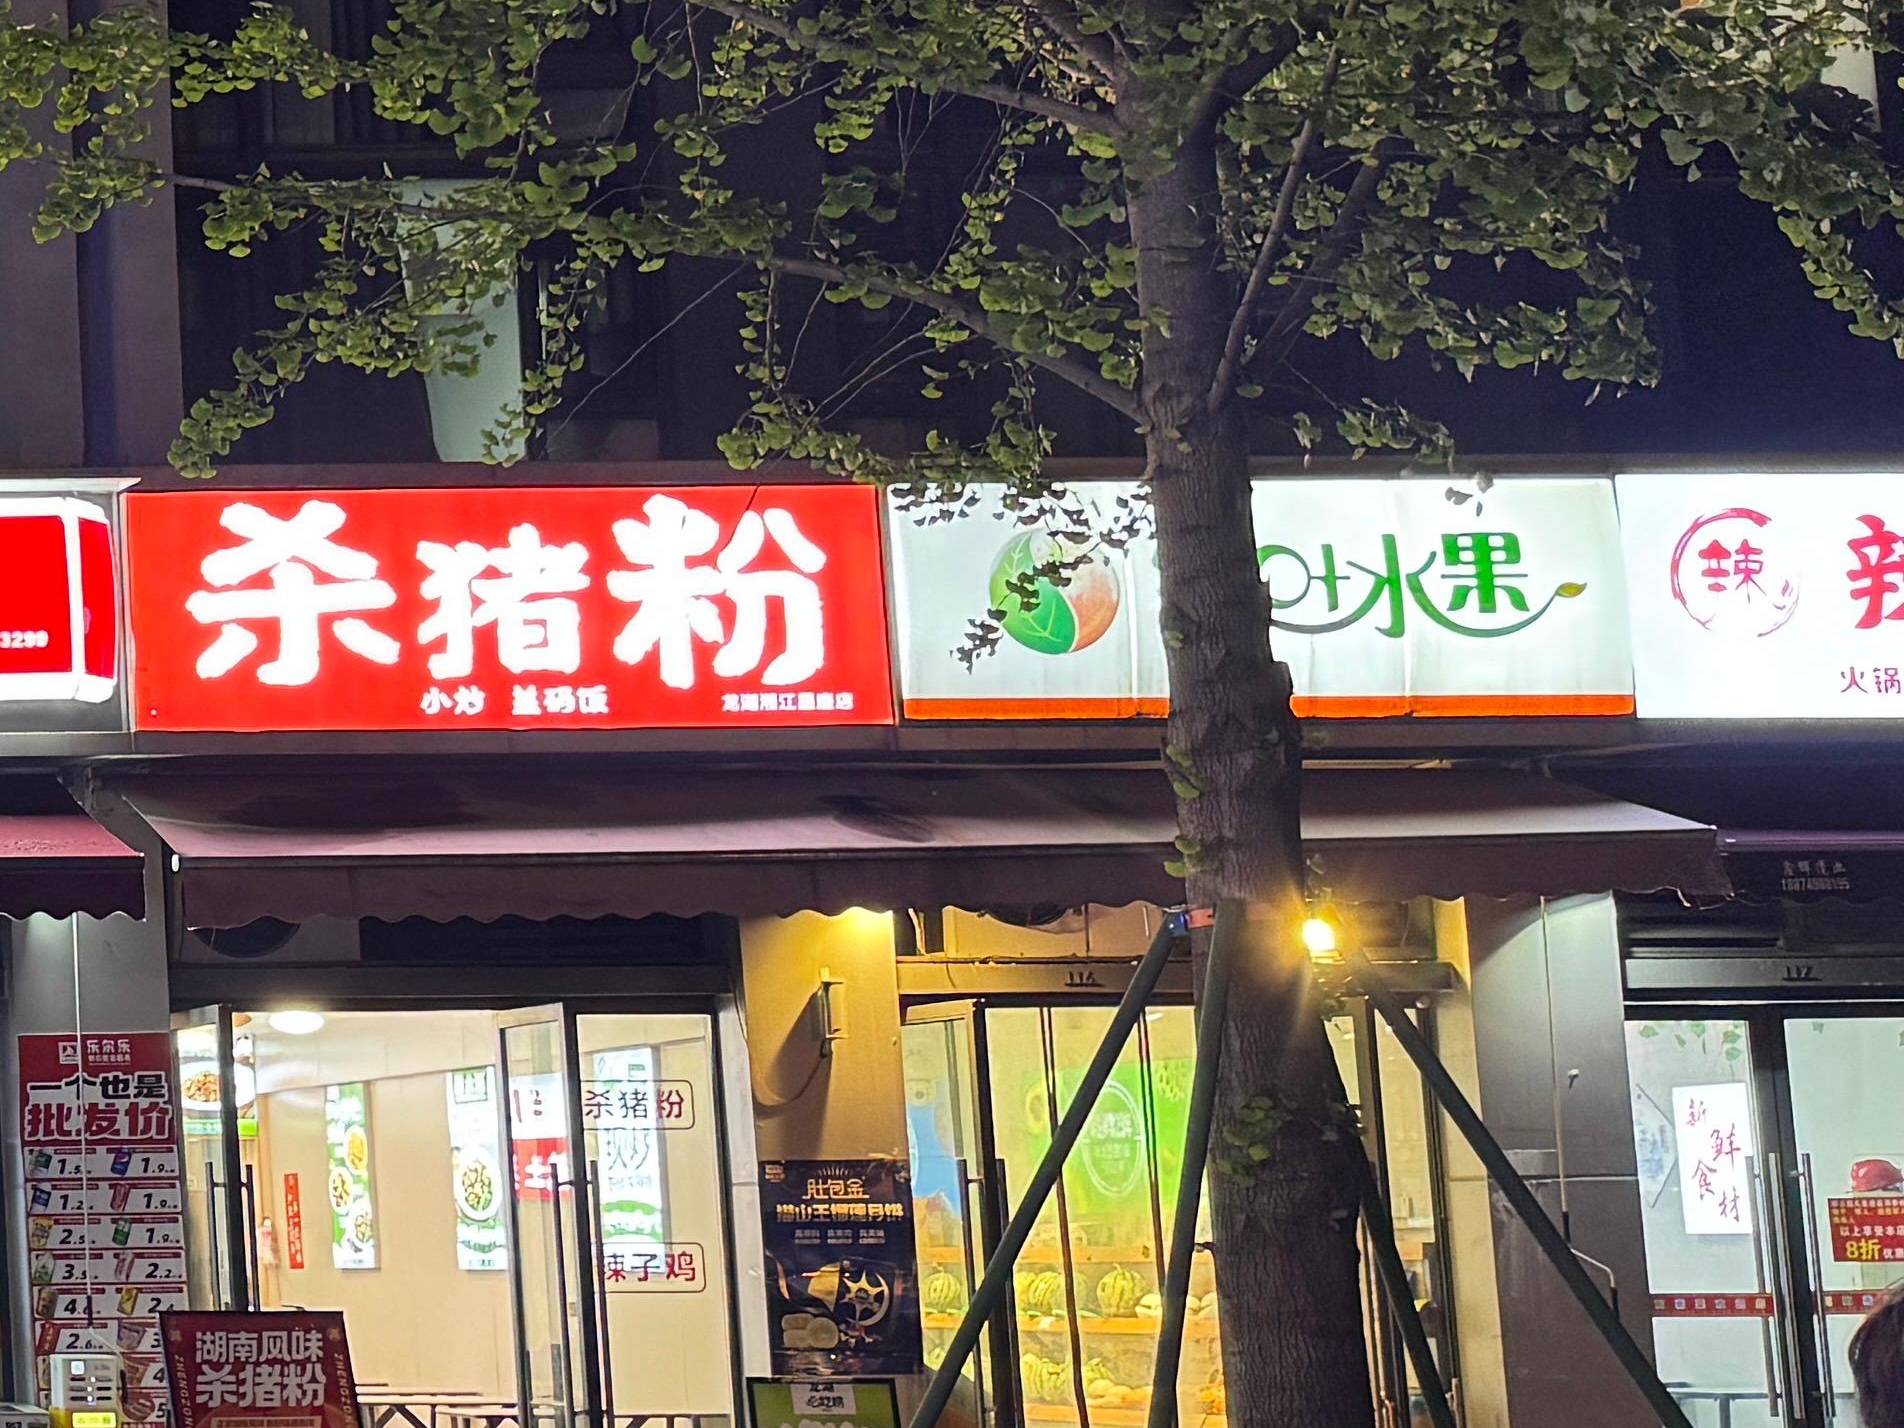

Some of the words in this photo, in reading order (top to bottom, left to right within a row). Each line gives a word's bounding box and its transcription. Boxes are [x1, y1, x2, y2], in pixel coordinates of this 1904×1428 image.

[191, 495, 828, 689] 杀猪粉
[1257, 531, 1587, 639] 叶水果
[1840, 666, 1902, 695] 火锅
[420, 685, 486, 716] 小炒
[28, 1074, 167, 1101] 一个也是
[26, 1101, 171, 1139] 批发价
[584, 1088, 684, 1120] 杀猪粉
[802, 1178, 871, 1200] 肚包金
[1845, 1237, 1882, 1261] 8折
[195, 1330, 324, 1363] 湖南风味
[195, 1363, 327, 1409] 杀猪粉
